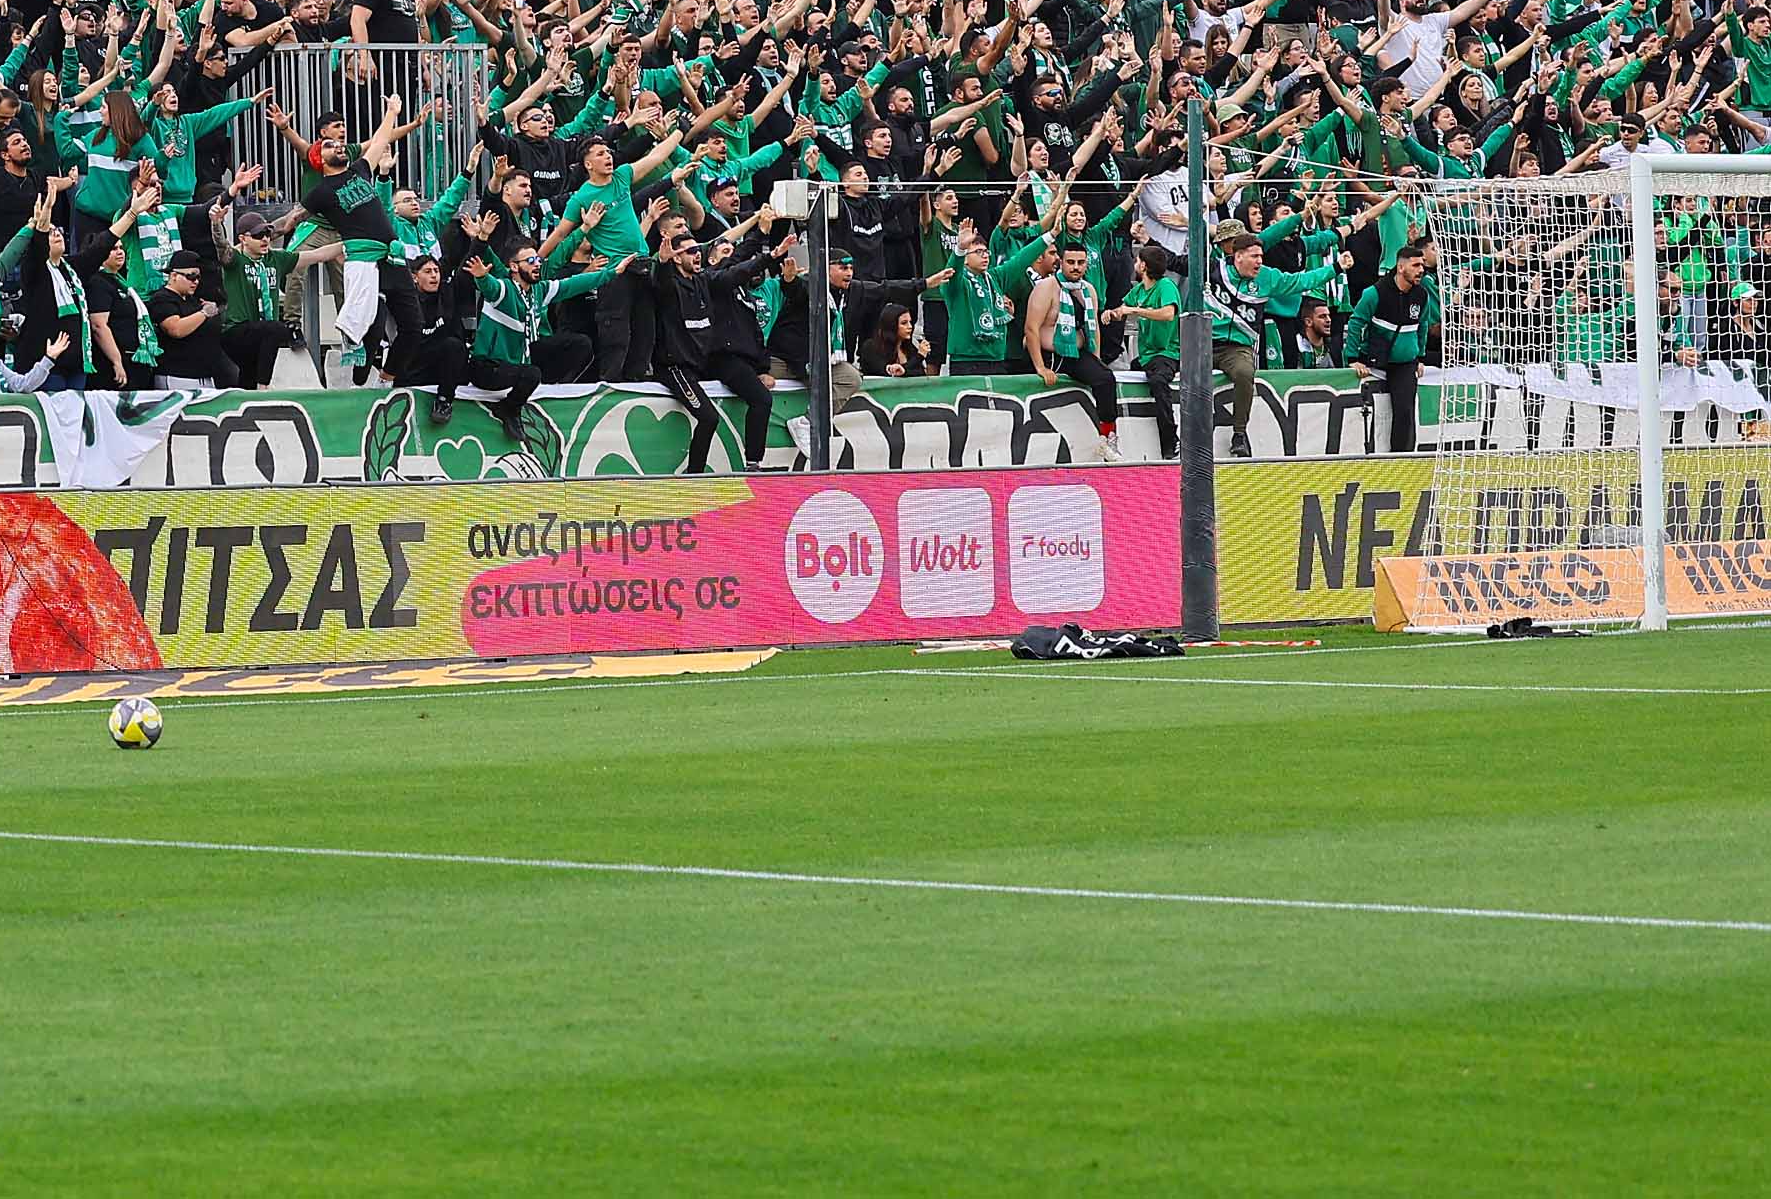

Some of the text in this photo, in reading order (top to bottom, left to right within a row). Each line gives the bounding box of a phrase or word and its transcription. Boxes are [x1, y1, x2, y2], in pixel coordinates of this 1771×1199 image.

[1170, 185, 1189, 205] GA
[468, 505, 699, 564] αναζητήστε
[795, 531, 873, 579] Bolt
[910, 534, 982, 573] Wolt
[1040, 534, 1090, 561] foody
[471, 566, 741, 619] εκπτώσεις σε
